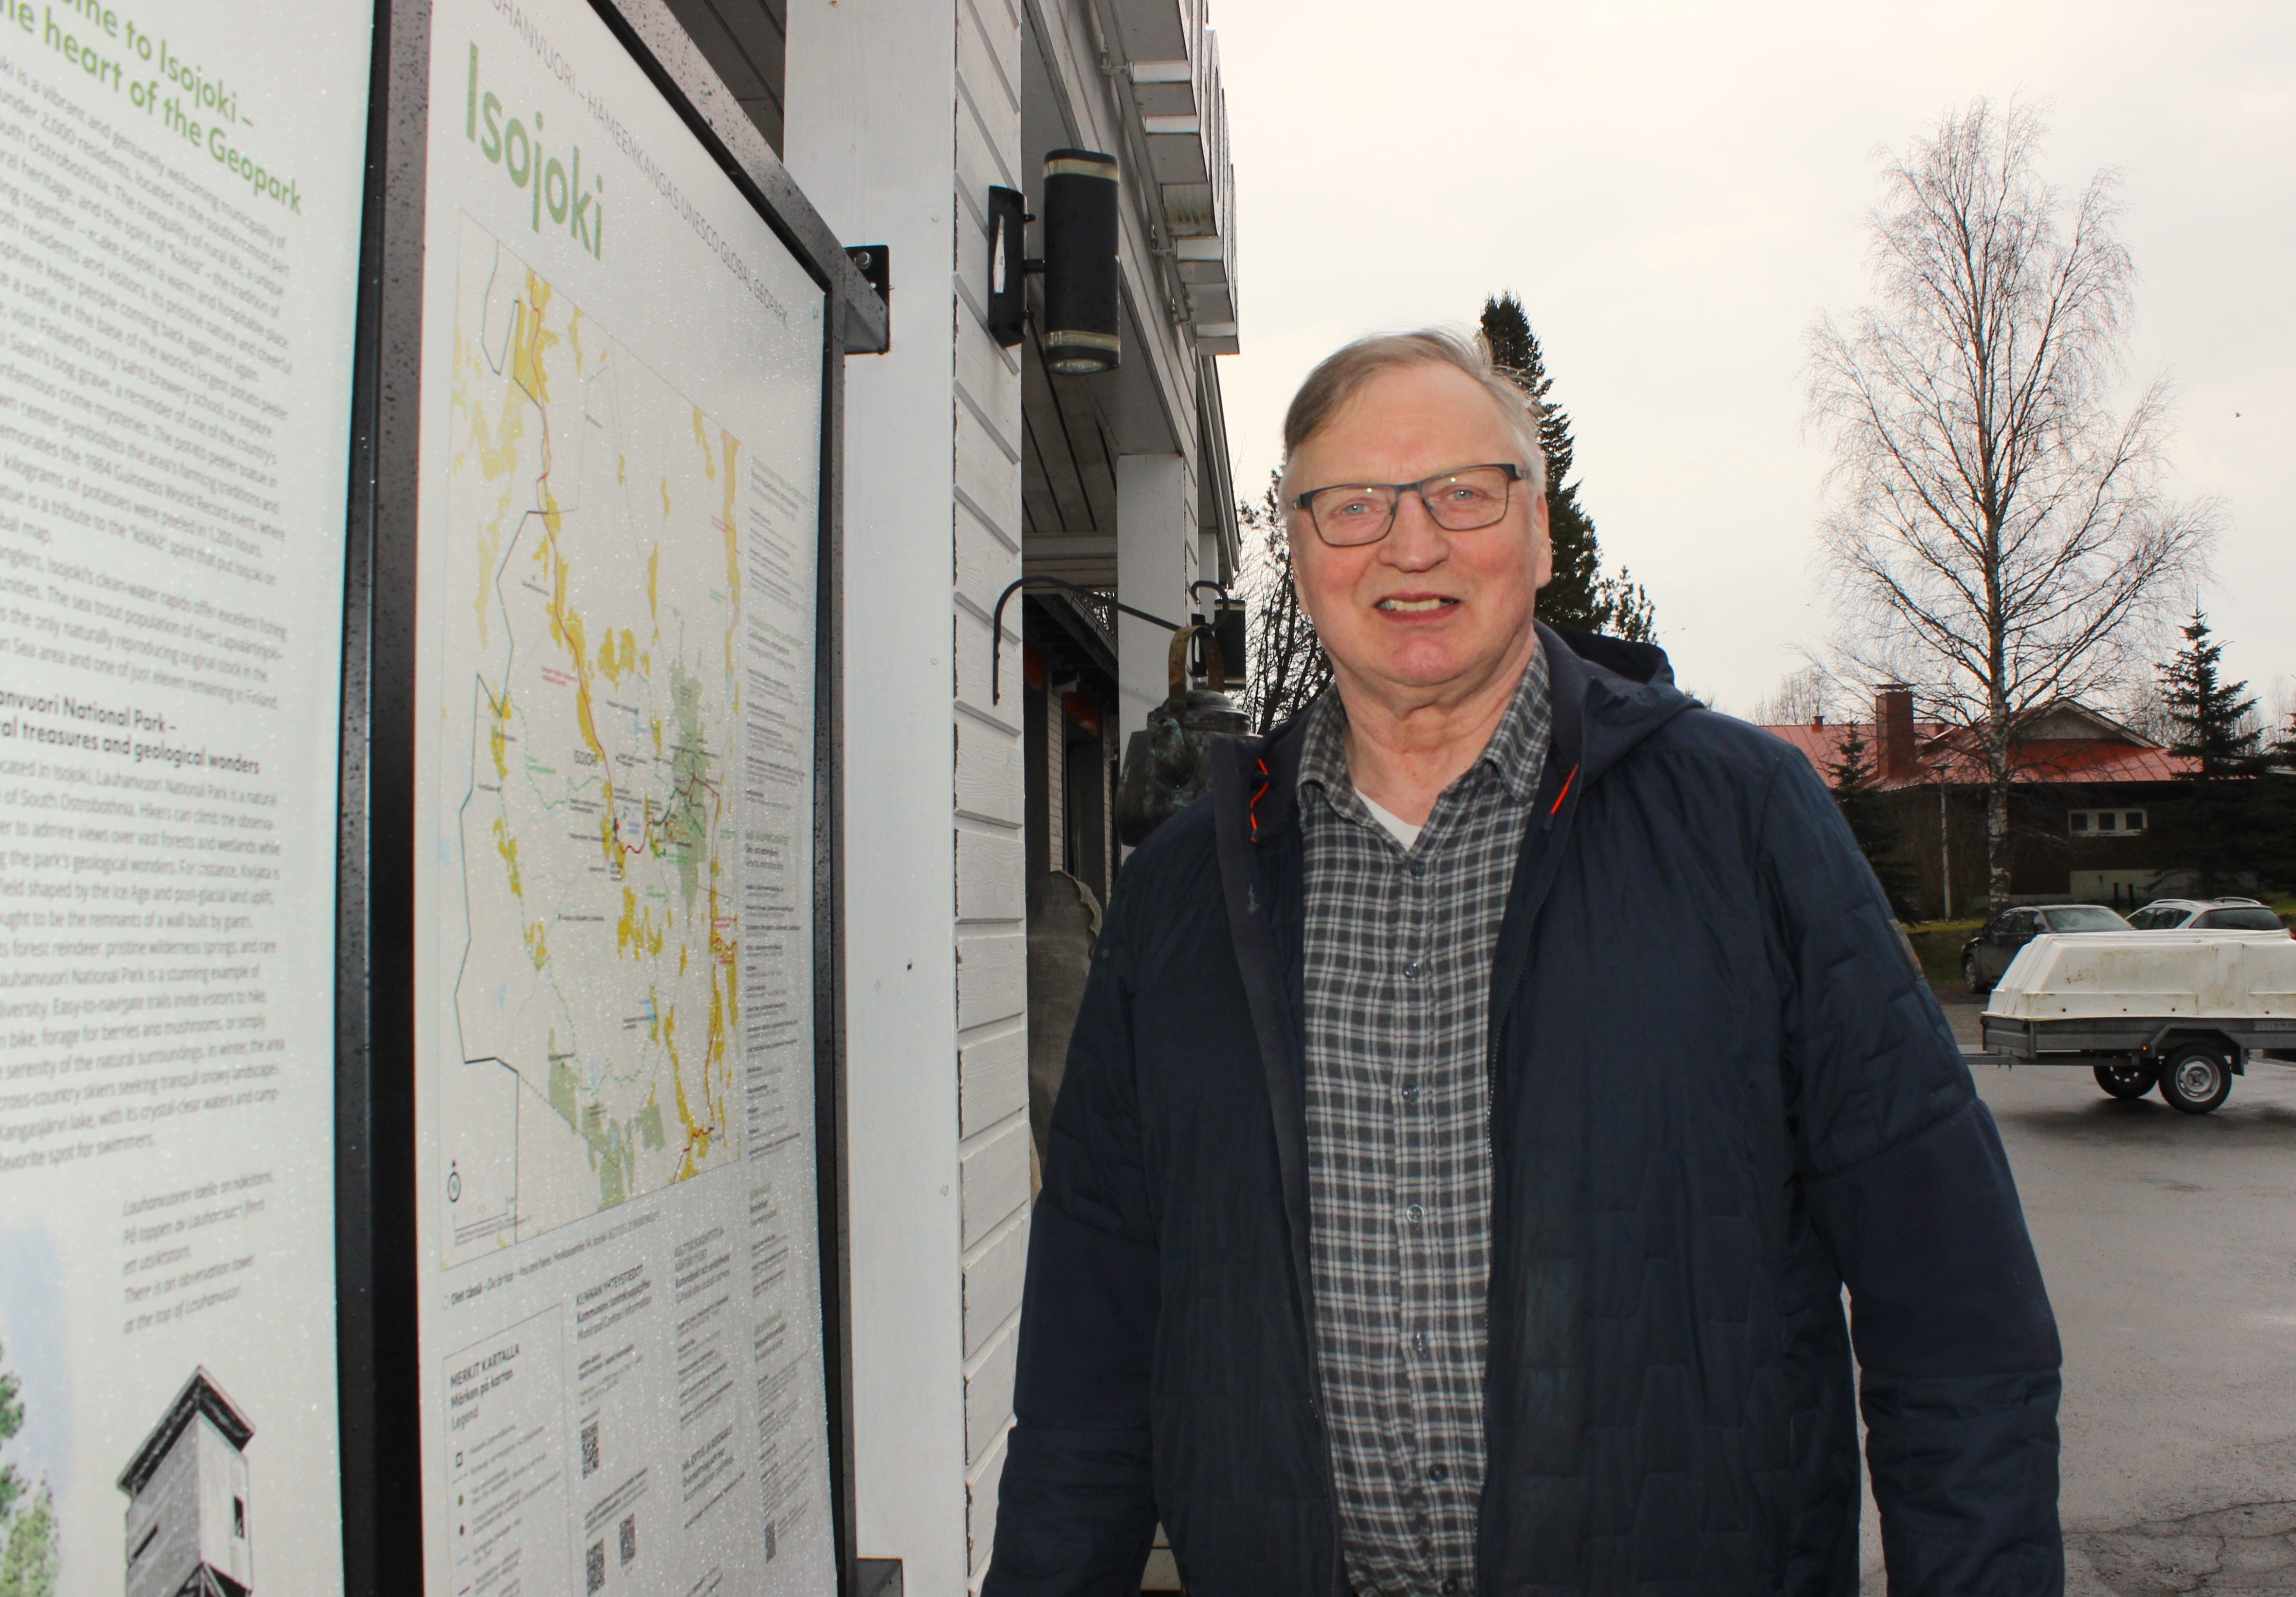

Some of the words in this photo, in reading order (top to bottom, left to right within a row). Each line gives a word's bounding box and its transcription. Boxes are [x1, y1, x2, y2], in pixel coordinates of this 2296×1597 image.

[63, 0, 117, 37] me
[126, 19, 151, 60] to
[159, 38, 236, 123] Isojoki
[45, 5, 122, 91] heart
[130, 81, 158, 114] of
[163, 97, 202, 147] the
[208, 127, 301, 215] Geopark
[467, 41, 603, 261] Isojoki
[588, 91, 679, 210] HÄMEENKANGAS
[681, 196, 718, 253] UNESCO
[720, 241, 752, 291] GLOBAL
[22, 719, 98, 751] treasures
[103, 732, 130, 756] and
[135, 737, 204, 772] geological
[209, 749, 259, 776] wonders
[63, 695, 130, 728] National
[134, 708, 166, 734] Park
[450, 1361, 479, 1390] MERKIT
[481, 1340, 520, 1373] KARTALLA
[451, 1404, 479, 1435] Legend
